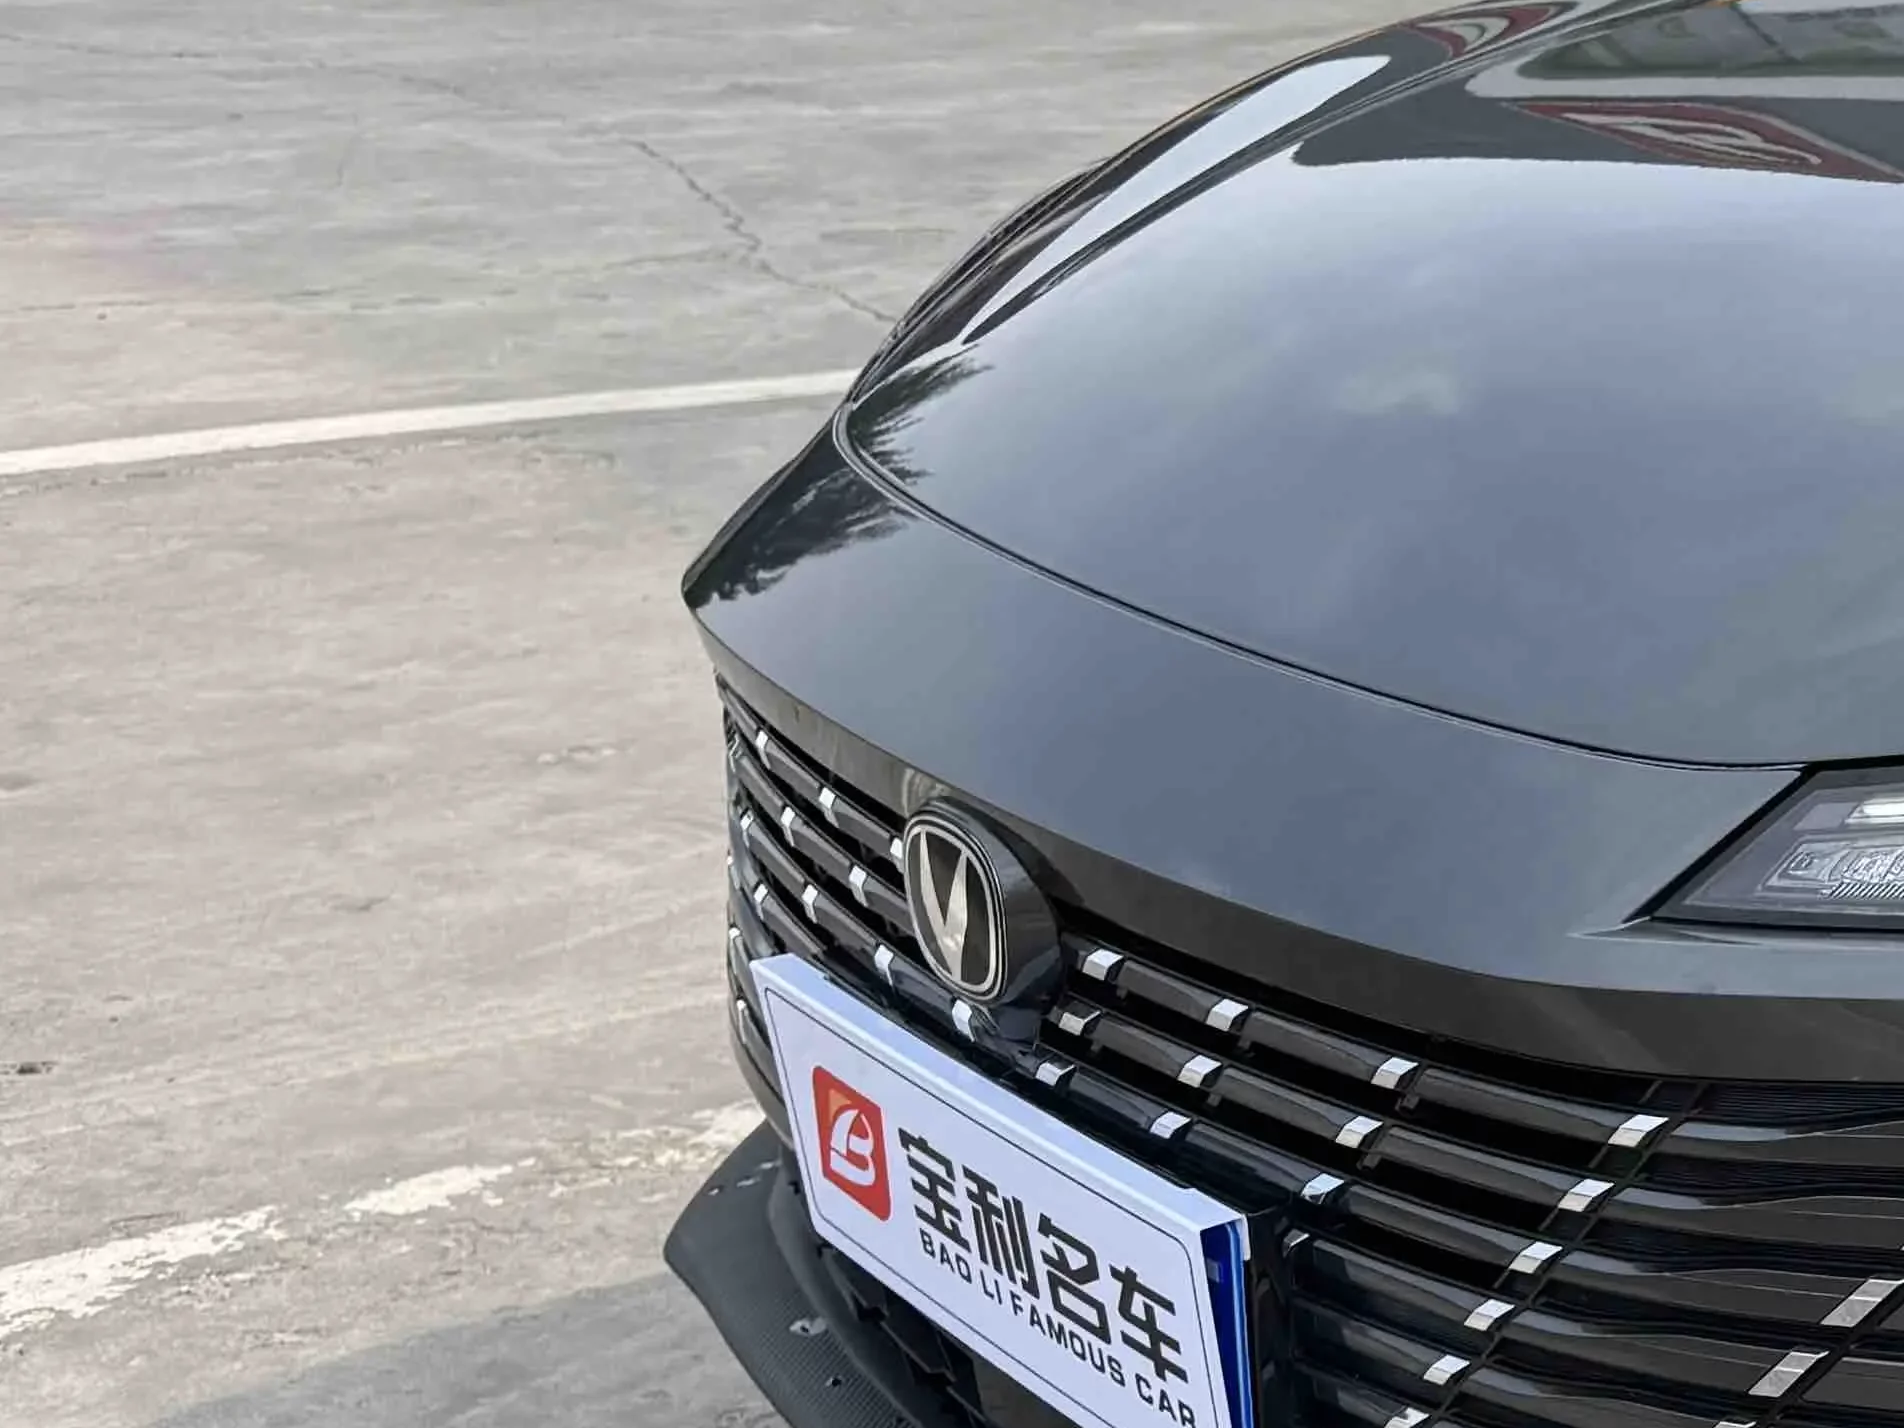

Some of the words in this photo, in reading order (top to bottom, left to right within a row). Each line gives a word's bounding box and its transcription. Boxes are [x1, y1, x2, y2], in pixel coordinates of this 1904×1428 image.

[898, 1127, 1189, 1384] 宝利名车
[920, 1227, 973, 1284] BAO
[982, 1276, 1003, 1305] LI
[1012, 1289, 1126, 1388] FAMOUS
